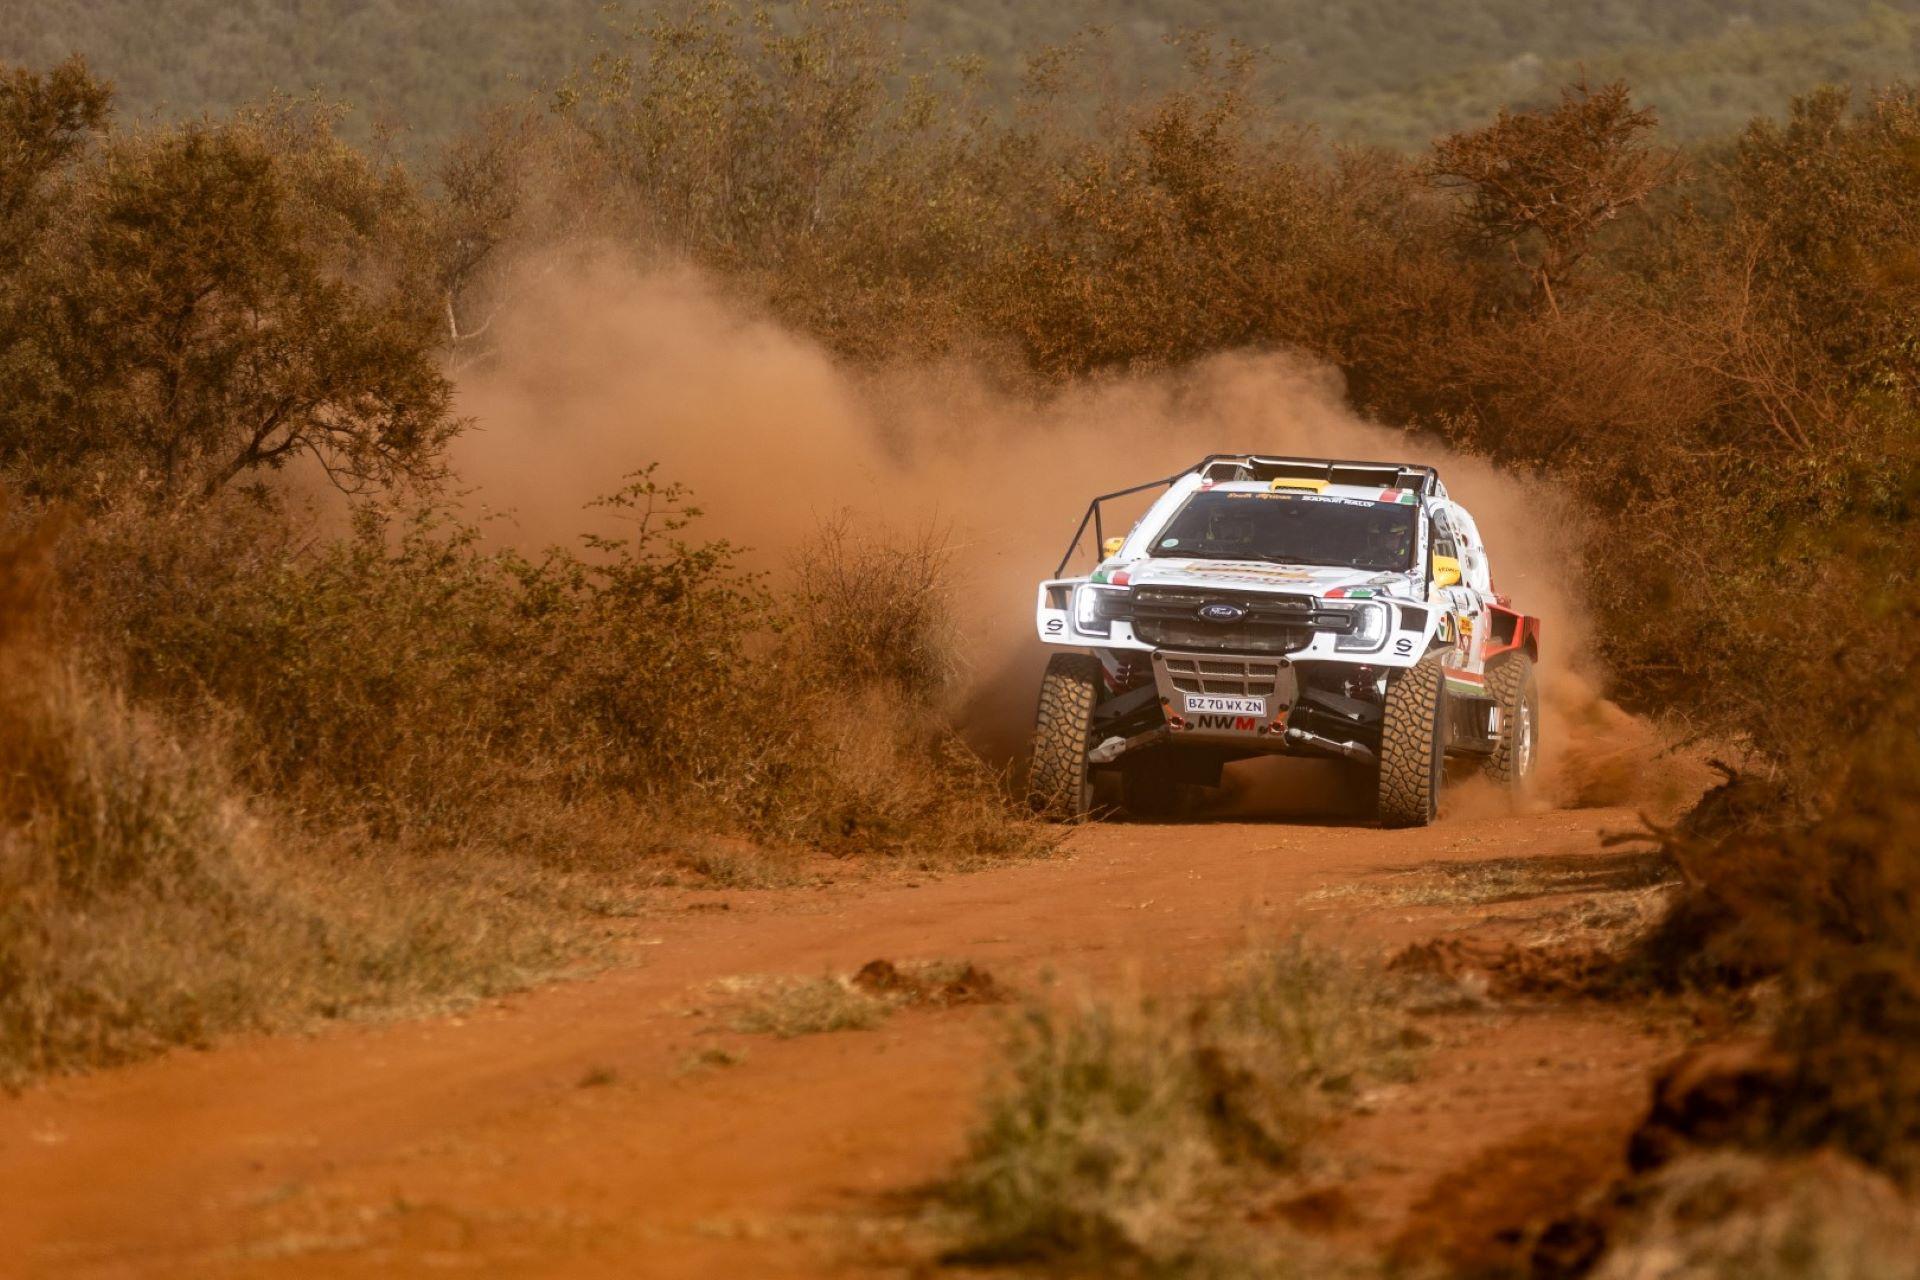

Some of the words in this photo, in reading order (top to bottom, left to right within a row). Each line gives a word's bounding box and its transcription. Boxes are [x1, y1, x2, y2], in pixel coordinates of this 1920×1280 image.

[1344, 500, 1375, 508] RALLY
[1210, 607, 1232, 616] Ford
[1189, 698, 1205, 709] BZ
[1226, 700, 1242, 711] WX
[1246, 701, 1262, 712] ZN
[1198, 715, 1256, 731] NWM
